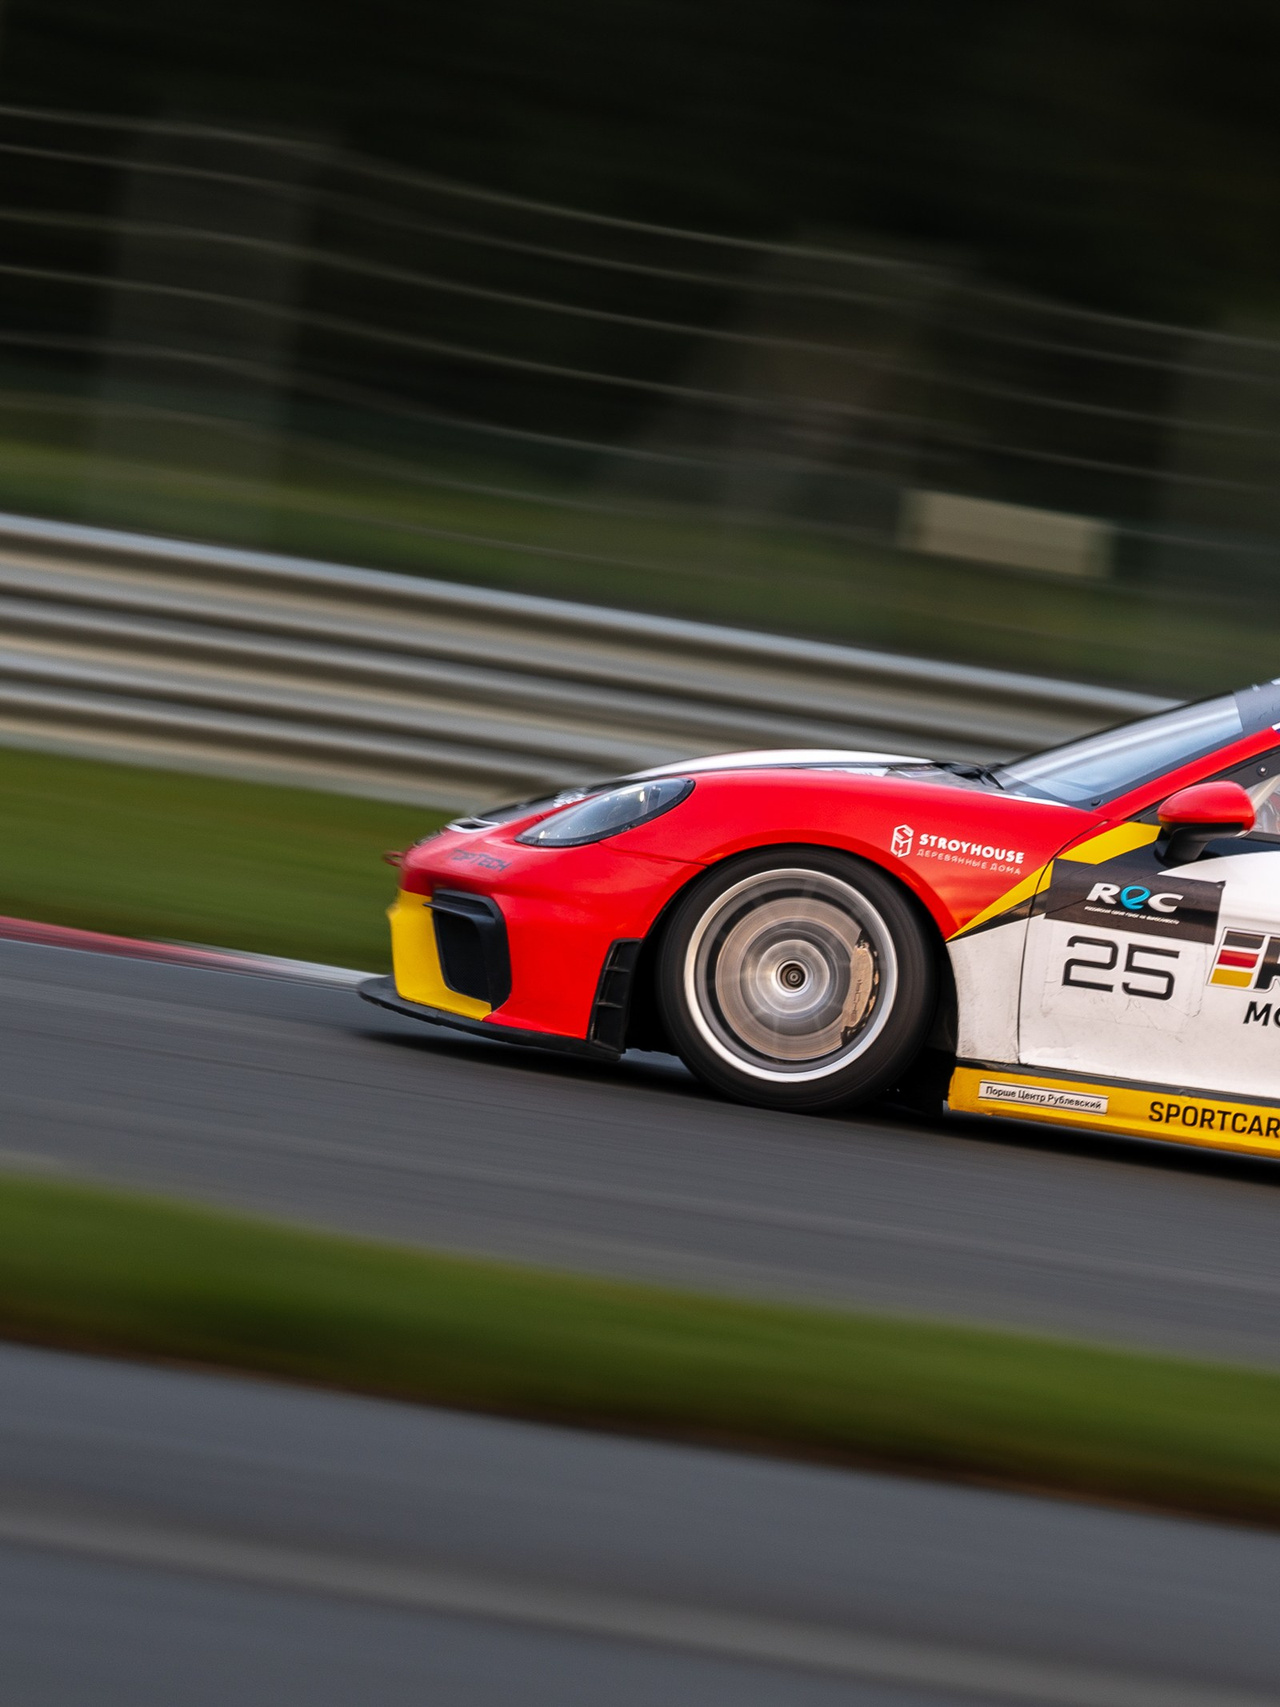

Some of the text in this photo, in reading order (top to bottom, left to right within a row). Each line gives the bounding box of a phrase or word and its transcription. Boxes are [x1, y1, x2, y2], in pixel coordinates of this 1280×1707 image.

[917, 848, 1022, 875] ДЕРЕВЯННЫЕ ДОМА
[919, 833, 1025, 864] STROYHOUSE
[1062, 935, 1180, 1001] 25
[986, 1086, 1102, 1109] Порше Центр Рублевский
[1148, 1101, 1280, 1138] SPORTCAR
